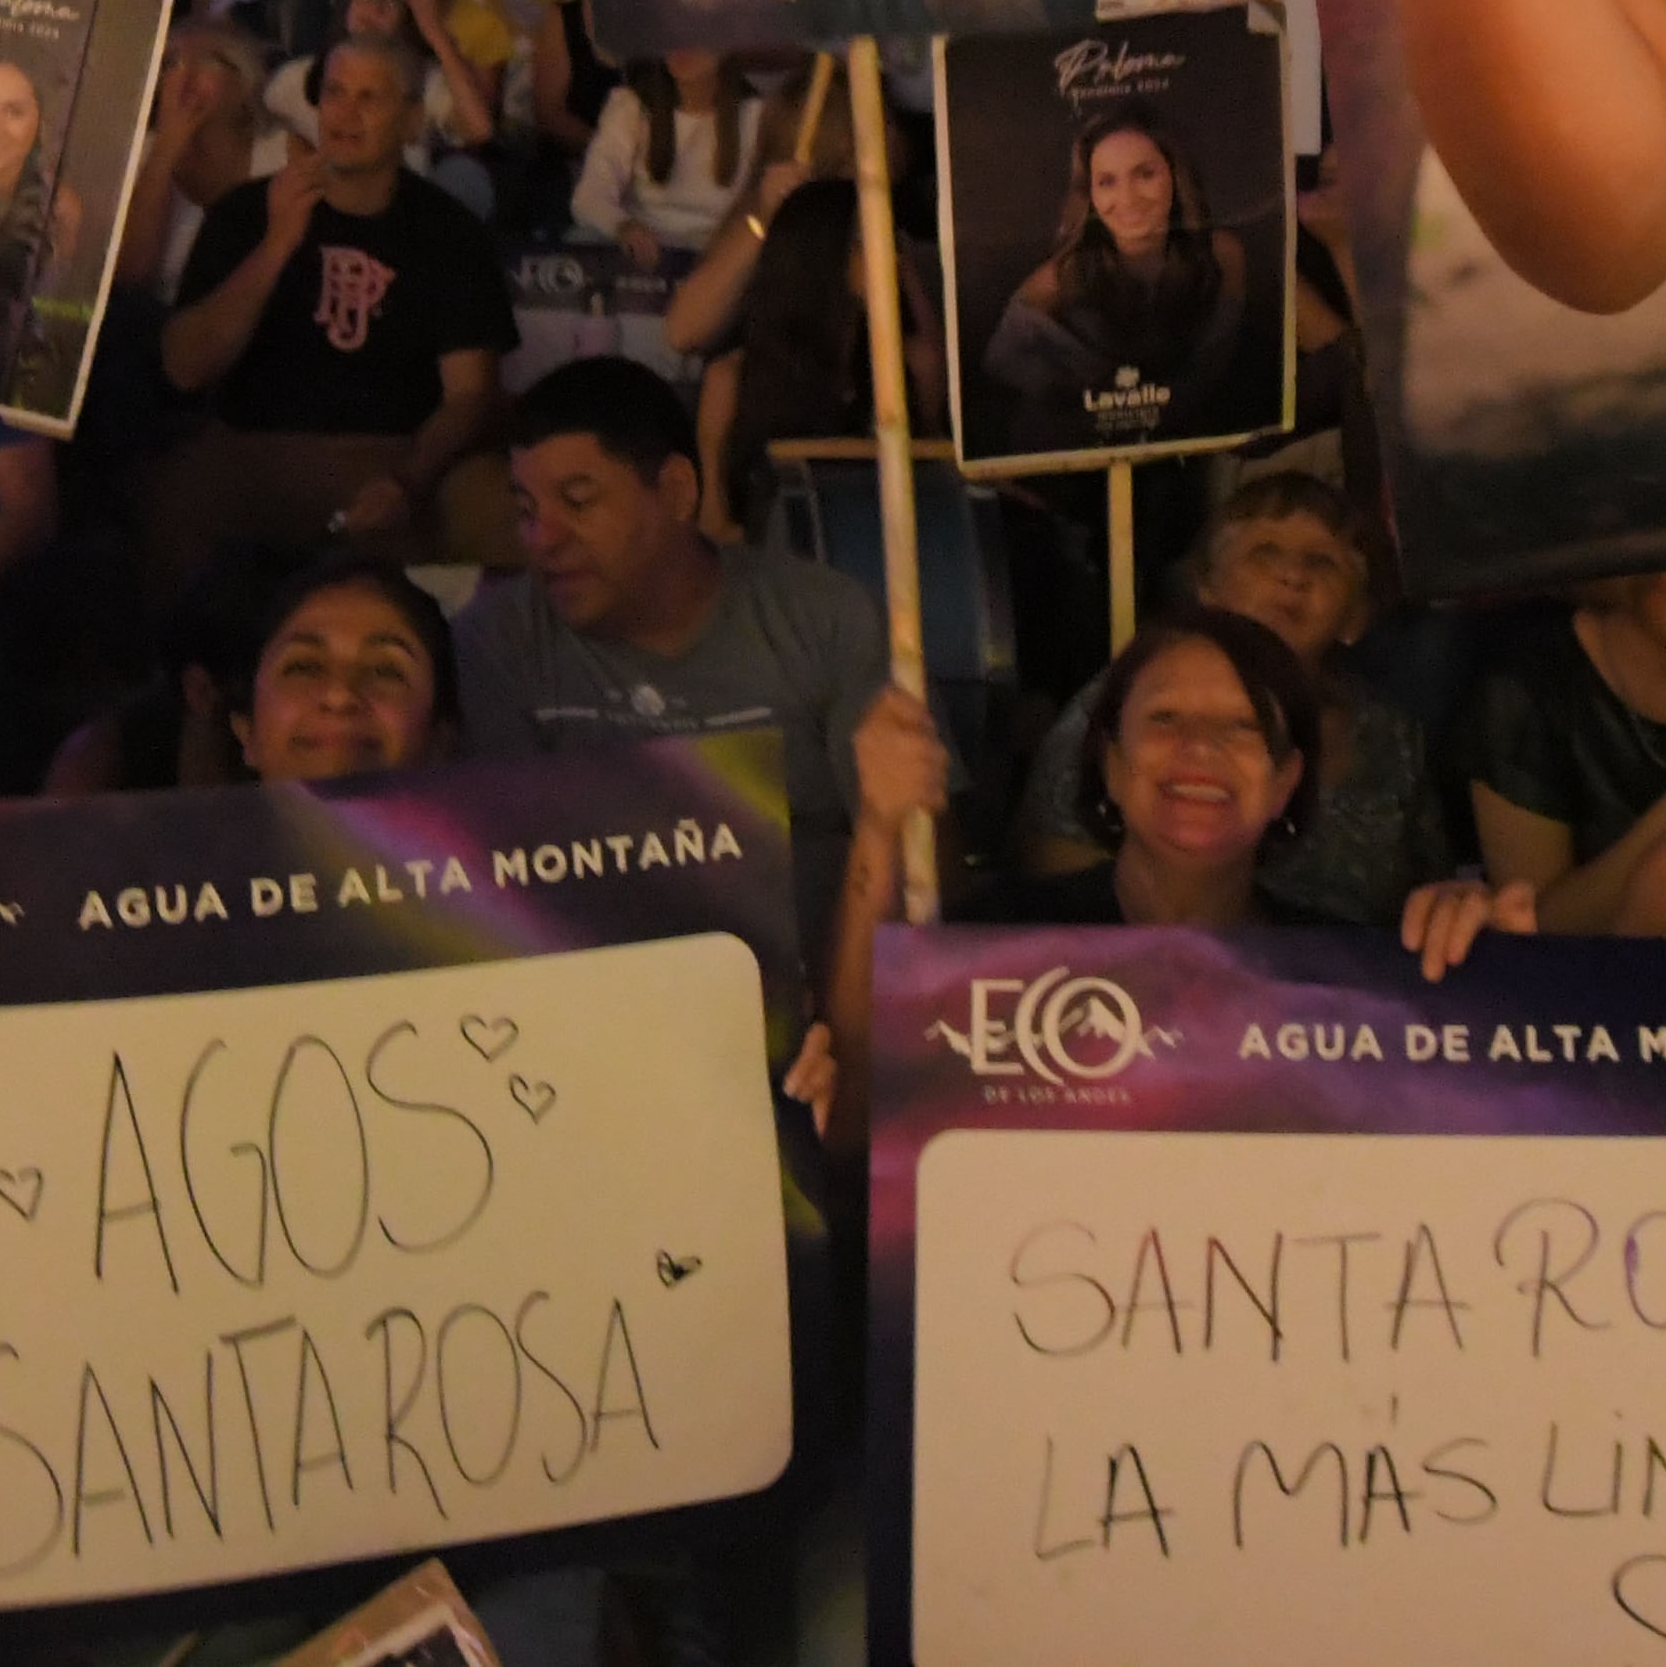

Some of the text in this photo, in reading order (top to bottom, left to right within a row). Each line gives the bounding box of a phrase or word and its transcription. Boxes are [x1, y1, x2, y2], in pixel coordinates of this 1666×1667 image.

[1082, 382, 1172, 412] Lavalle
[77, 816, 747, 932] AGUA DE ALTA MONTAÑA
[970, 966, 1143, 1086] ECO
[1239, 1022, 1383, 1063] AGUA
[1404, 1022, 1471, 1065] DE
[1487, 1024, 1622, 1066] ALTA
[91, 1020, 495, 1295] AGOS
[1009, 1222, 1470, 1362] SANTA
[1034, 1437, 1173, 1563] LA
[1231, 1395, 1501, 1548] MÁS
